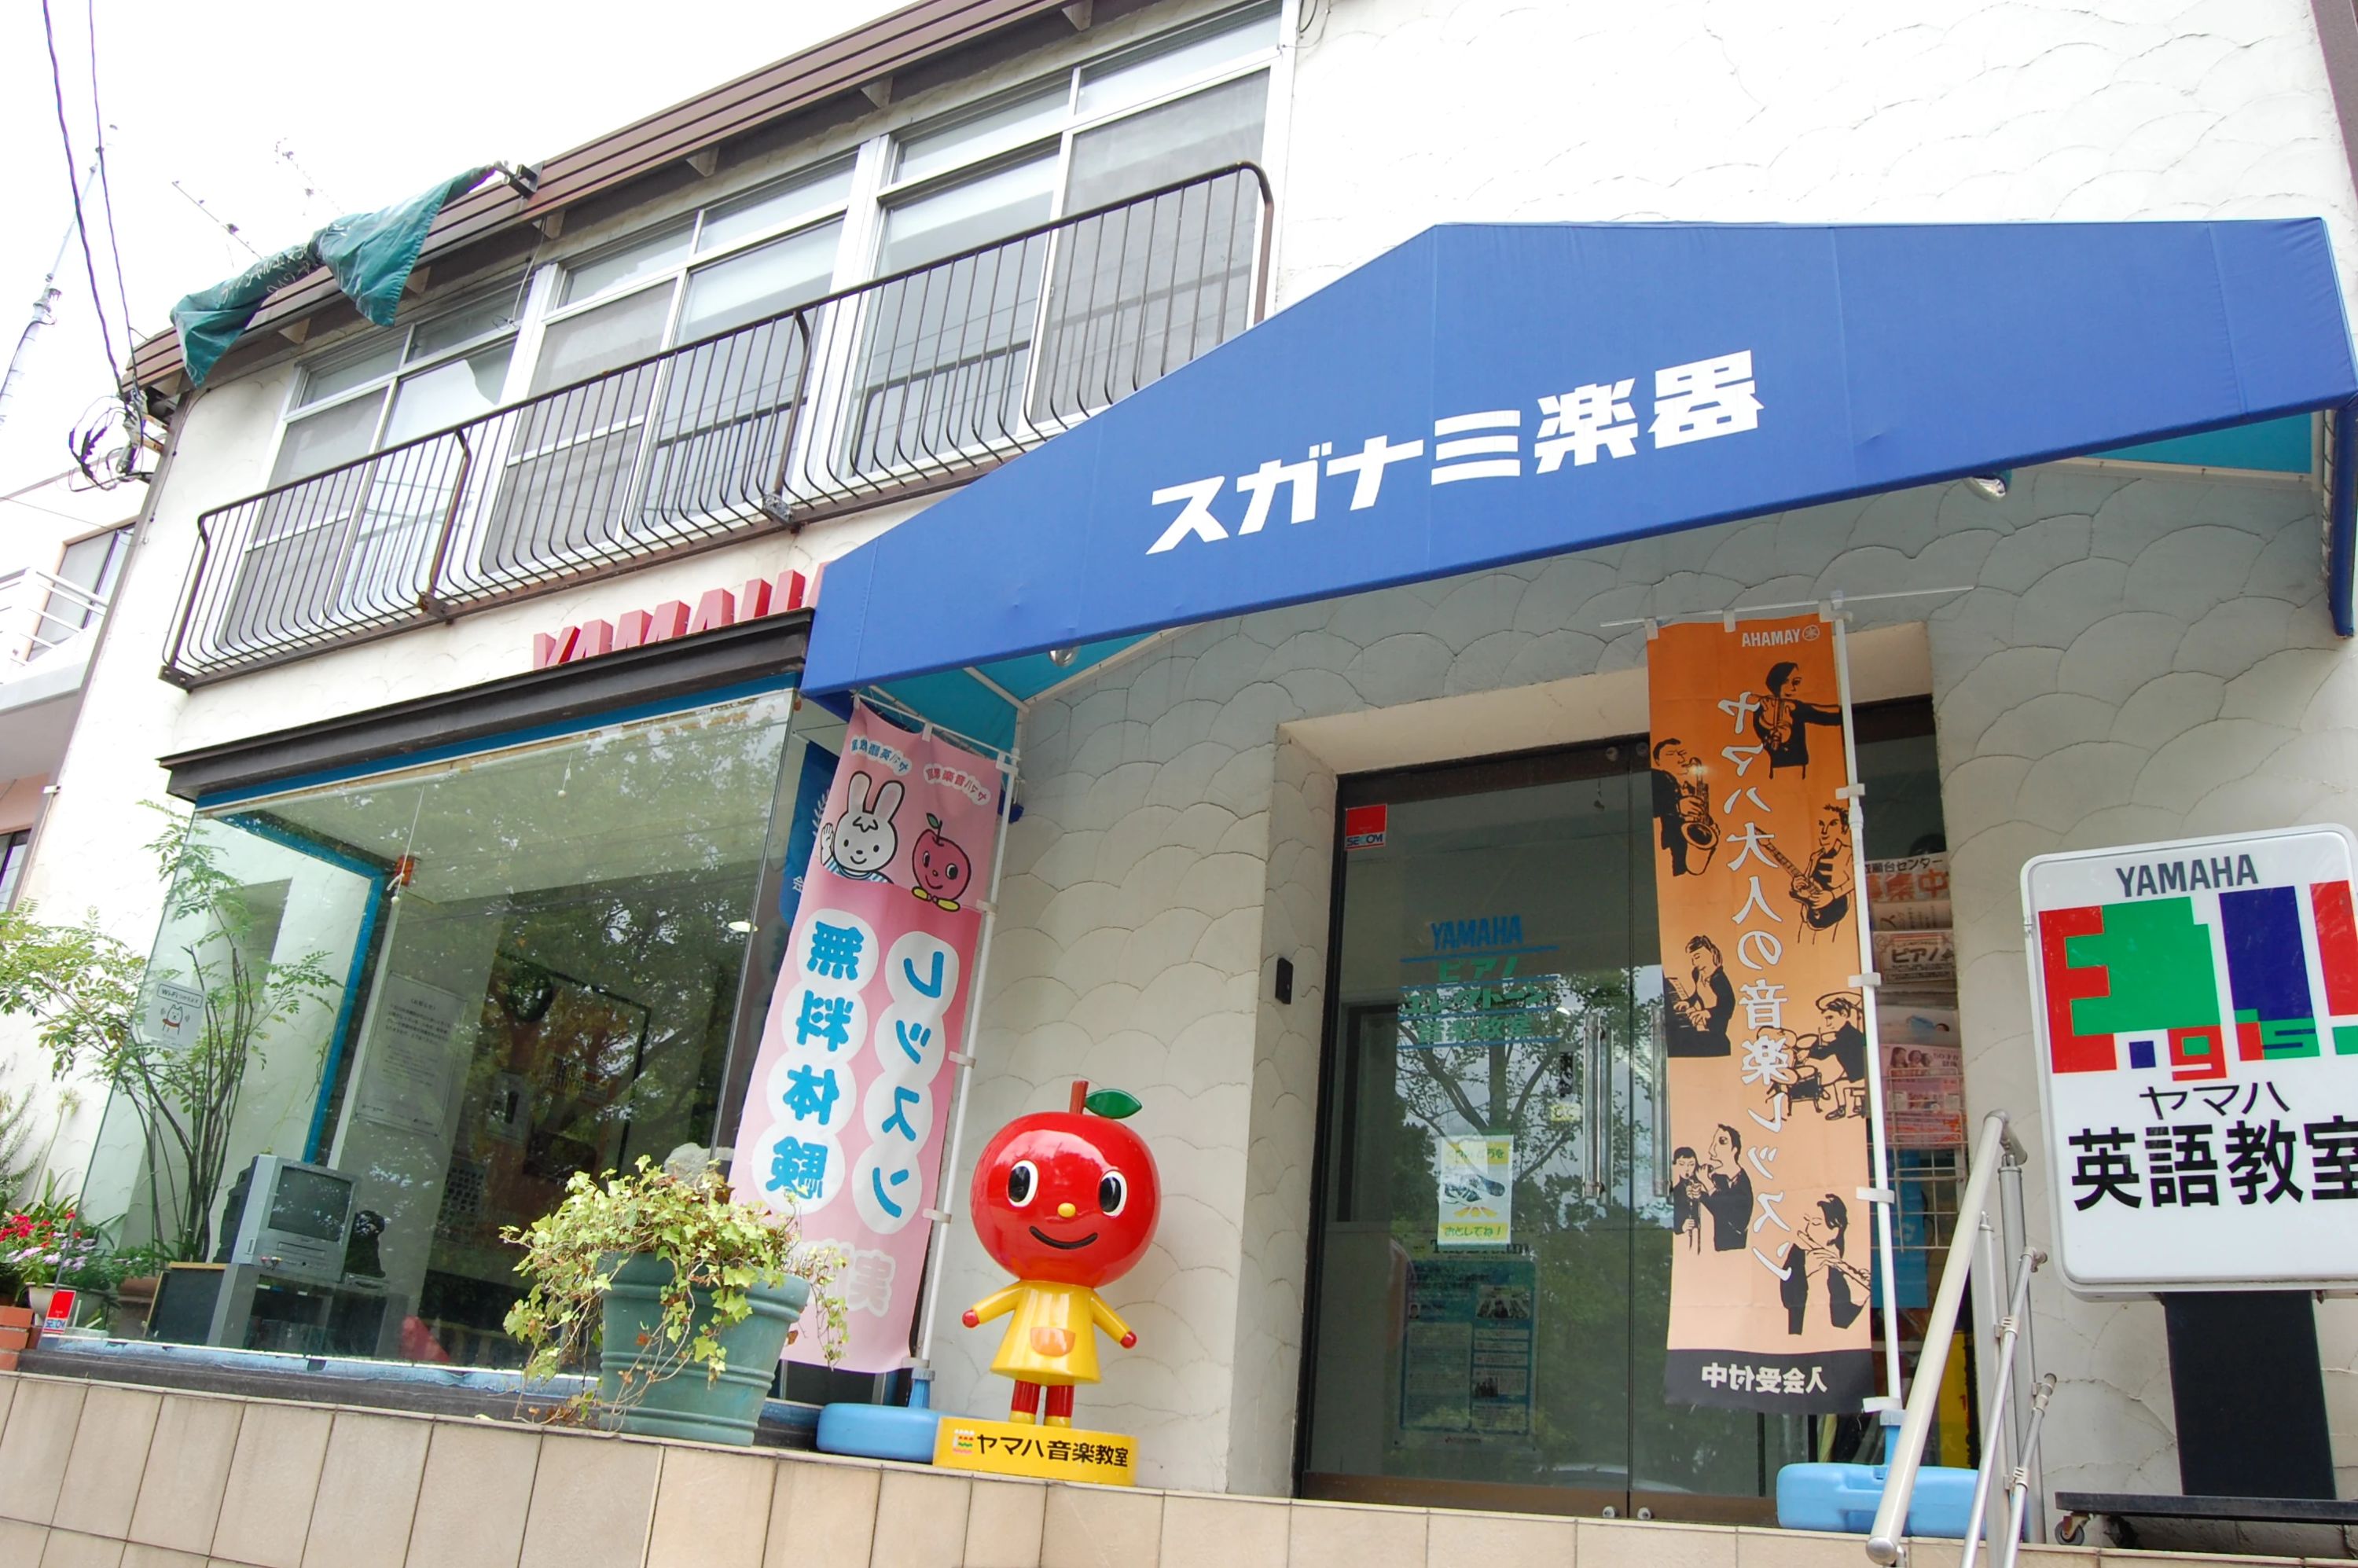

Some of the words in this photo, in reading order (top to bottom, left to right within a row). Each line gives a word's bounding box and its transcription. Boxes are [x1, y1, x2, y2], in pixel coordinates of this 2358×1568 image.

[1146, 350, 1764, 555] スガナミ楽器
[1346, 833, 1383, 846] SECOM
[2116, 854, 2258, 898] YAMAHA
[1431, 914, 1524, 950] YAMAHA
[1438, 956, 1519, 982] ピアノ
[1403, 985, 1548, 1015] エレクトーン
[2139, 1081, 2290, 1119] ヤマハ
[2067, 1116, 2358, 1211] 英語教室
[977, 1434, 1129, 1467] ヤマハ音楽教室
